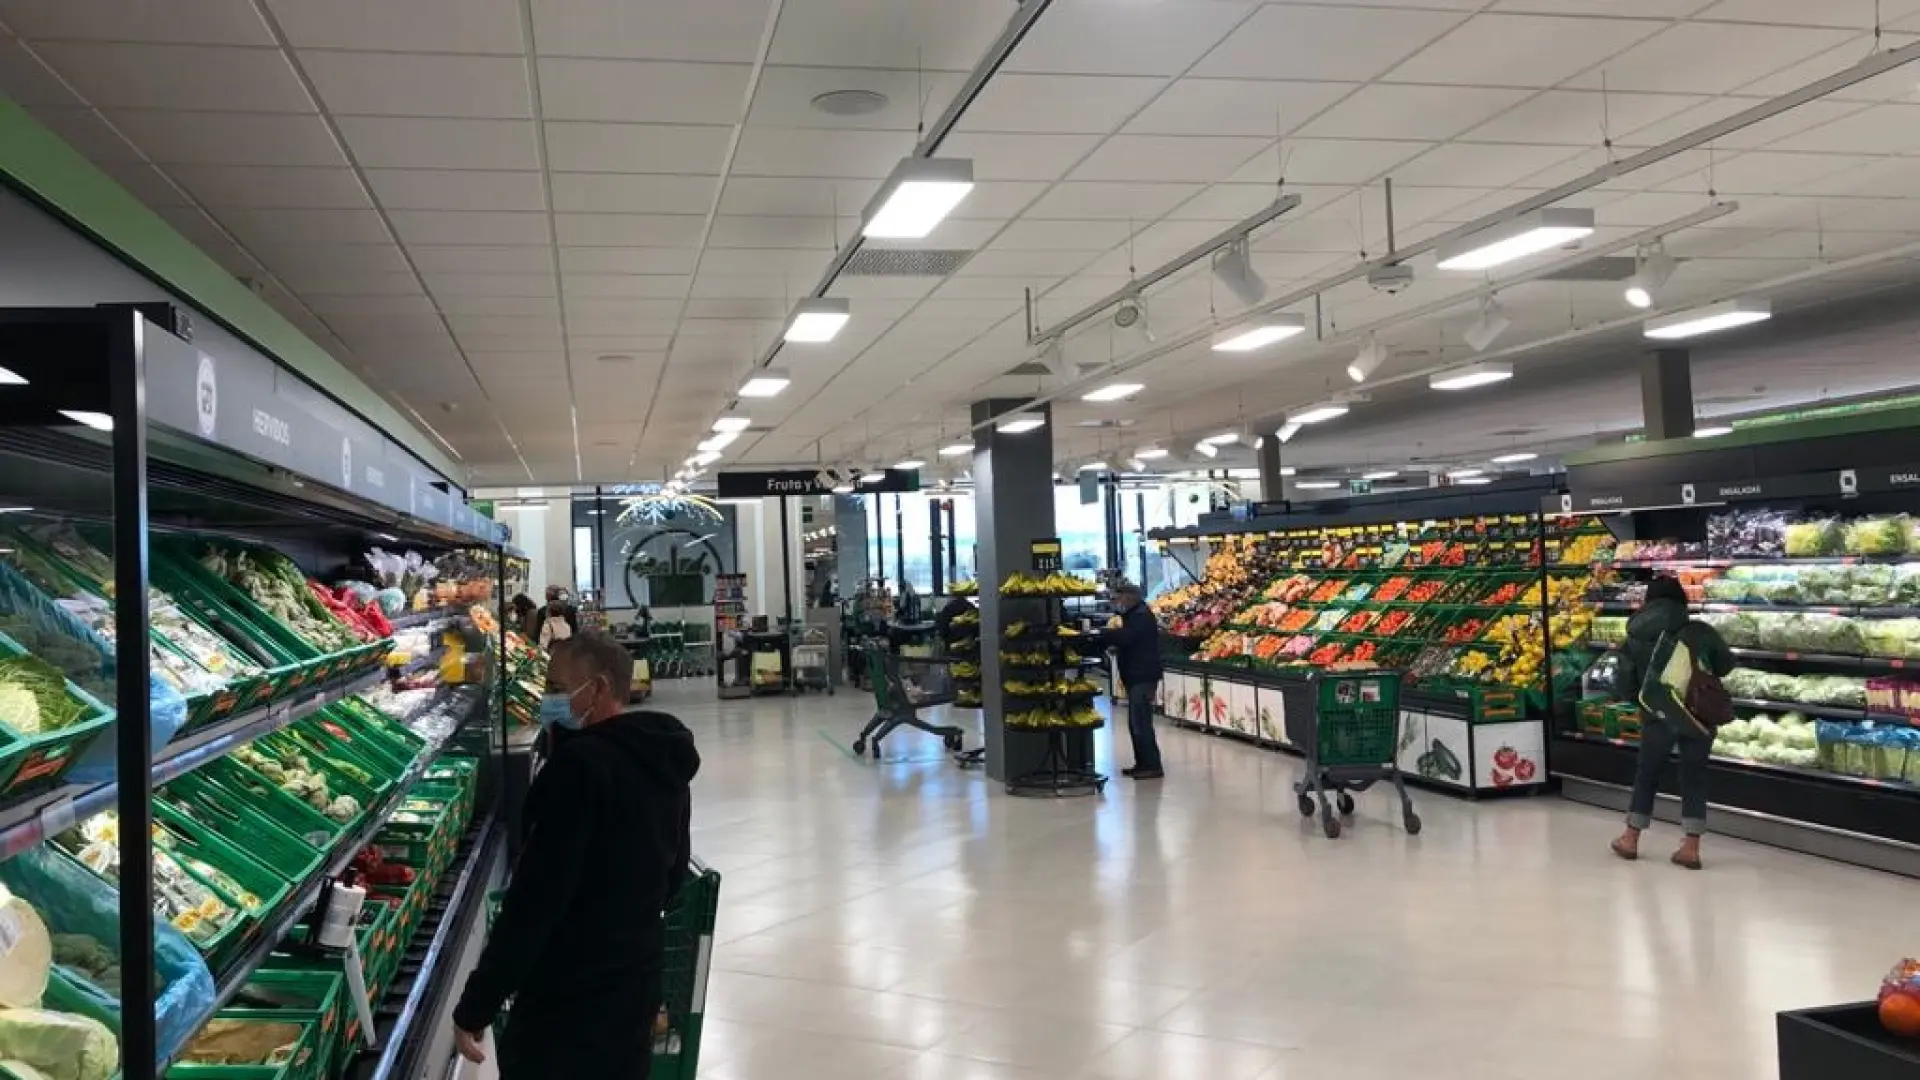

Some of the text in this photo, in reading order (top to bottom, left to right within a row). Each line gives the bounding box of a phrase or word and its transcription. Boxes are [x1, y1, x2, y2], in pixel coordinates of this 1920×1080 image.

[253, 408, 290, 446] HERVIDOS
[767, 478, 803, 491] Fruta
[804, 480, 813, 492] y
